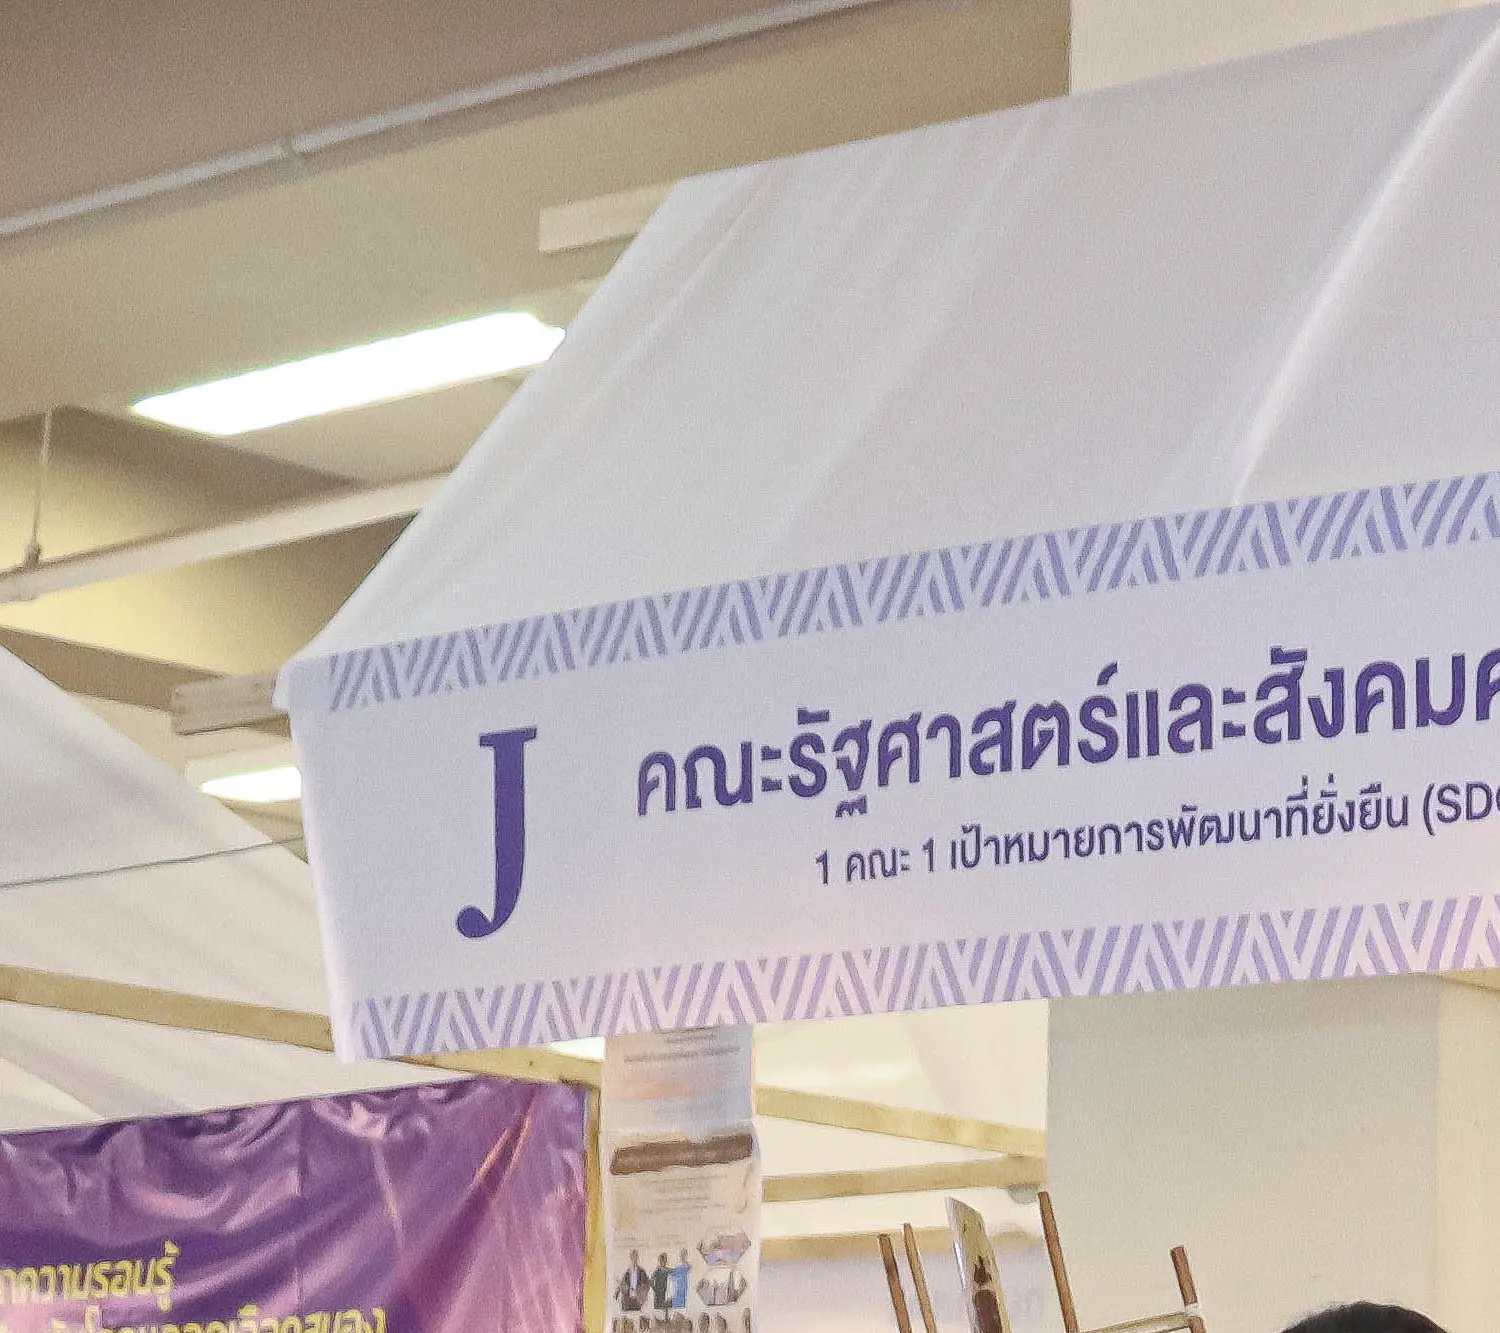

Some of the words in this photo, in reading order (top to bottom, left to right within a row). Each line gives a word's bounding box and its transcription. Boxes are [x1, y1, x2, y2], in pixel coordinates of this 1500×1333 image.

[456, 726, 536, 939] J
[815, 851, 830, 885] 1
[922, 839, 937, 872] 1
[950, 774, 1410, 870] เป้าหมายการพัฒนาที่ยั่งยืน
